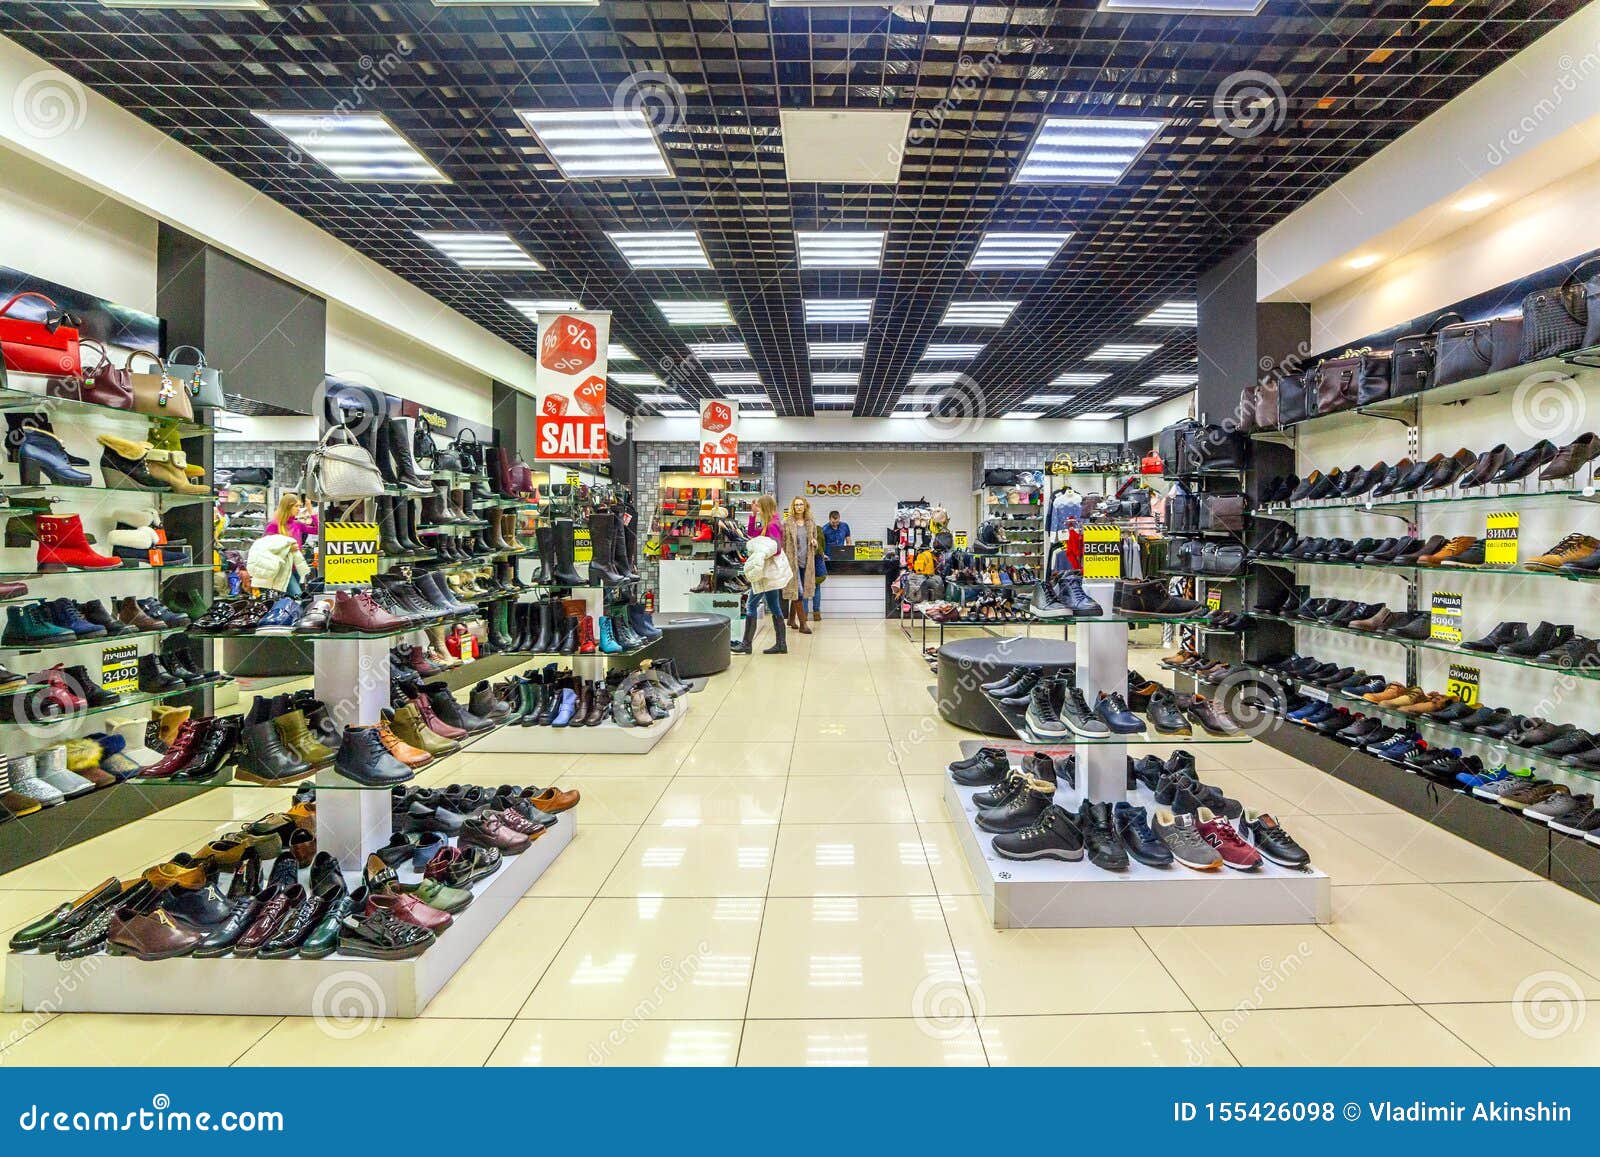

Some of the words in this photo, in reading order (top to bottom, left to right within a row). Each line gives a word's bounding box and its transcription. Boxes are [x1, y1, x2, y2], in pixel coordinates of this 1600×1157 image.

[542, 422, 605, 455] SALE
[703, 457, 736, 474] SALE
[805, 480, 862, 495] bootee
[1487, 529, 1517, 539] ЗИМА
[326, 541, 375, 555] NEW
[1084, 543, 1120, 553] ВЕСНА
[327, 556, 375, 565] collection
[1432, 596, 1461, 606] ЛУЧШАЯ
[103, 650, 137, 661] ЛУЧШАЯ
[103, 667, 138, 684] 3490
[1449, 669, 1479, 682] СКИДКА
